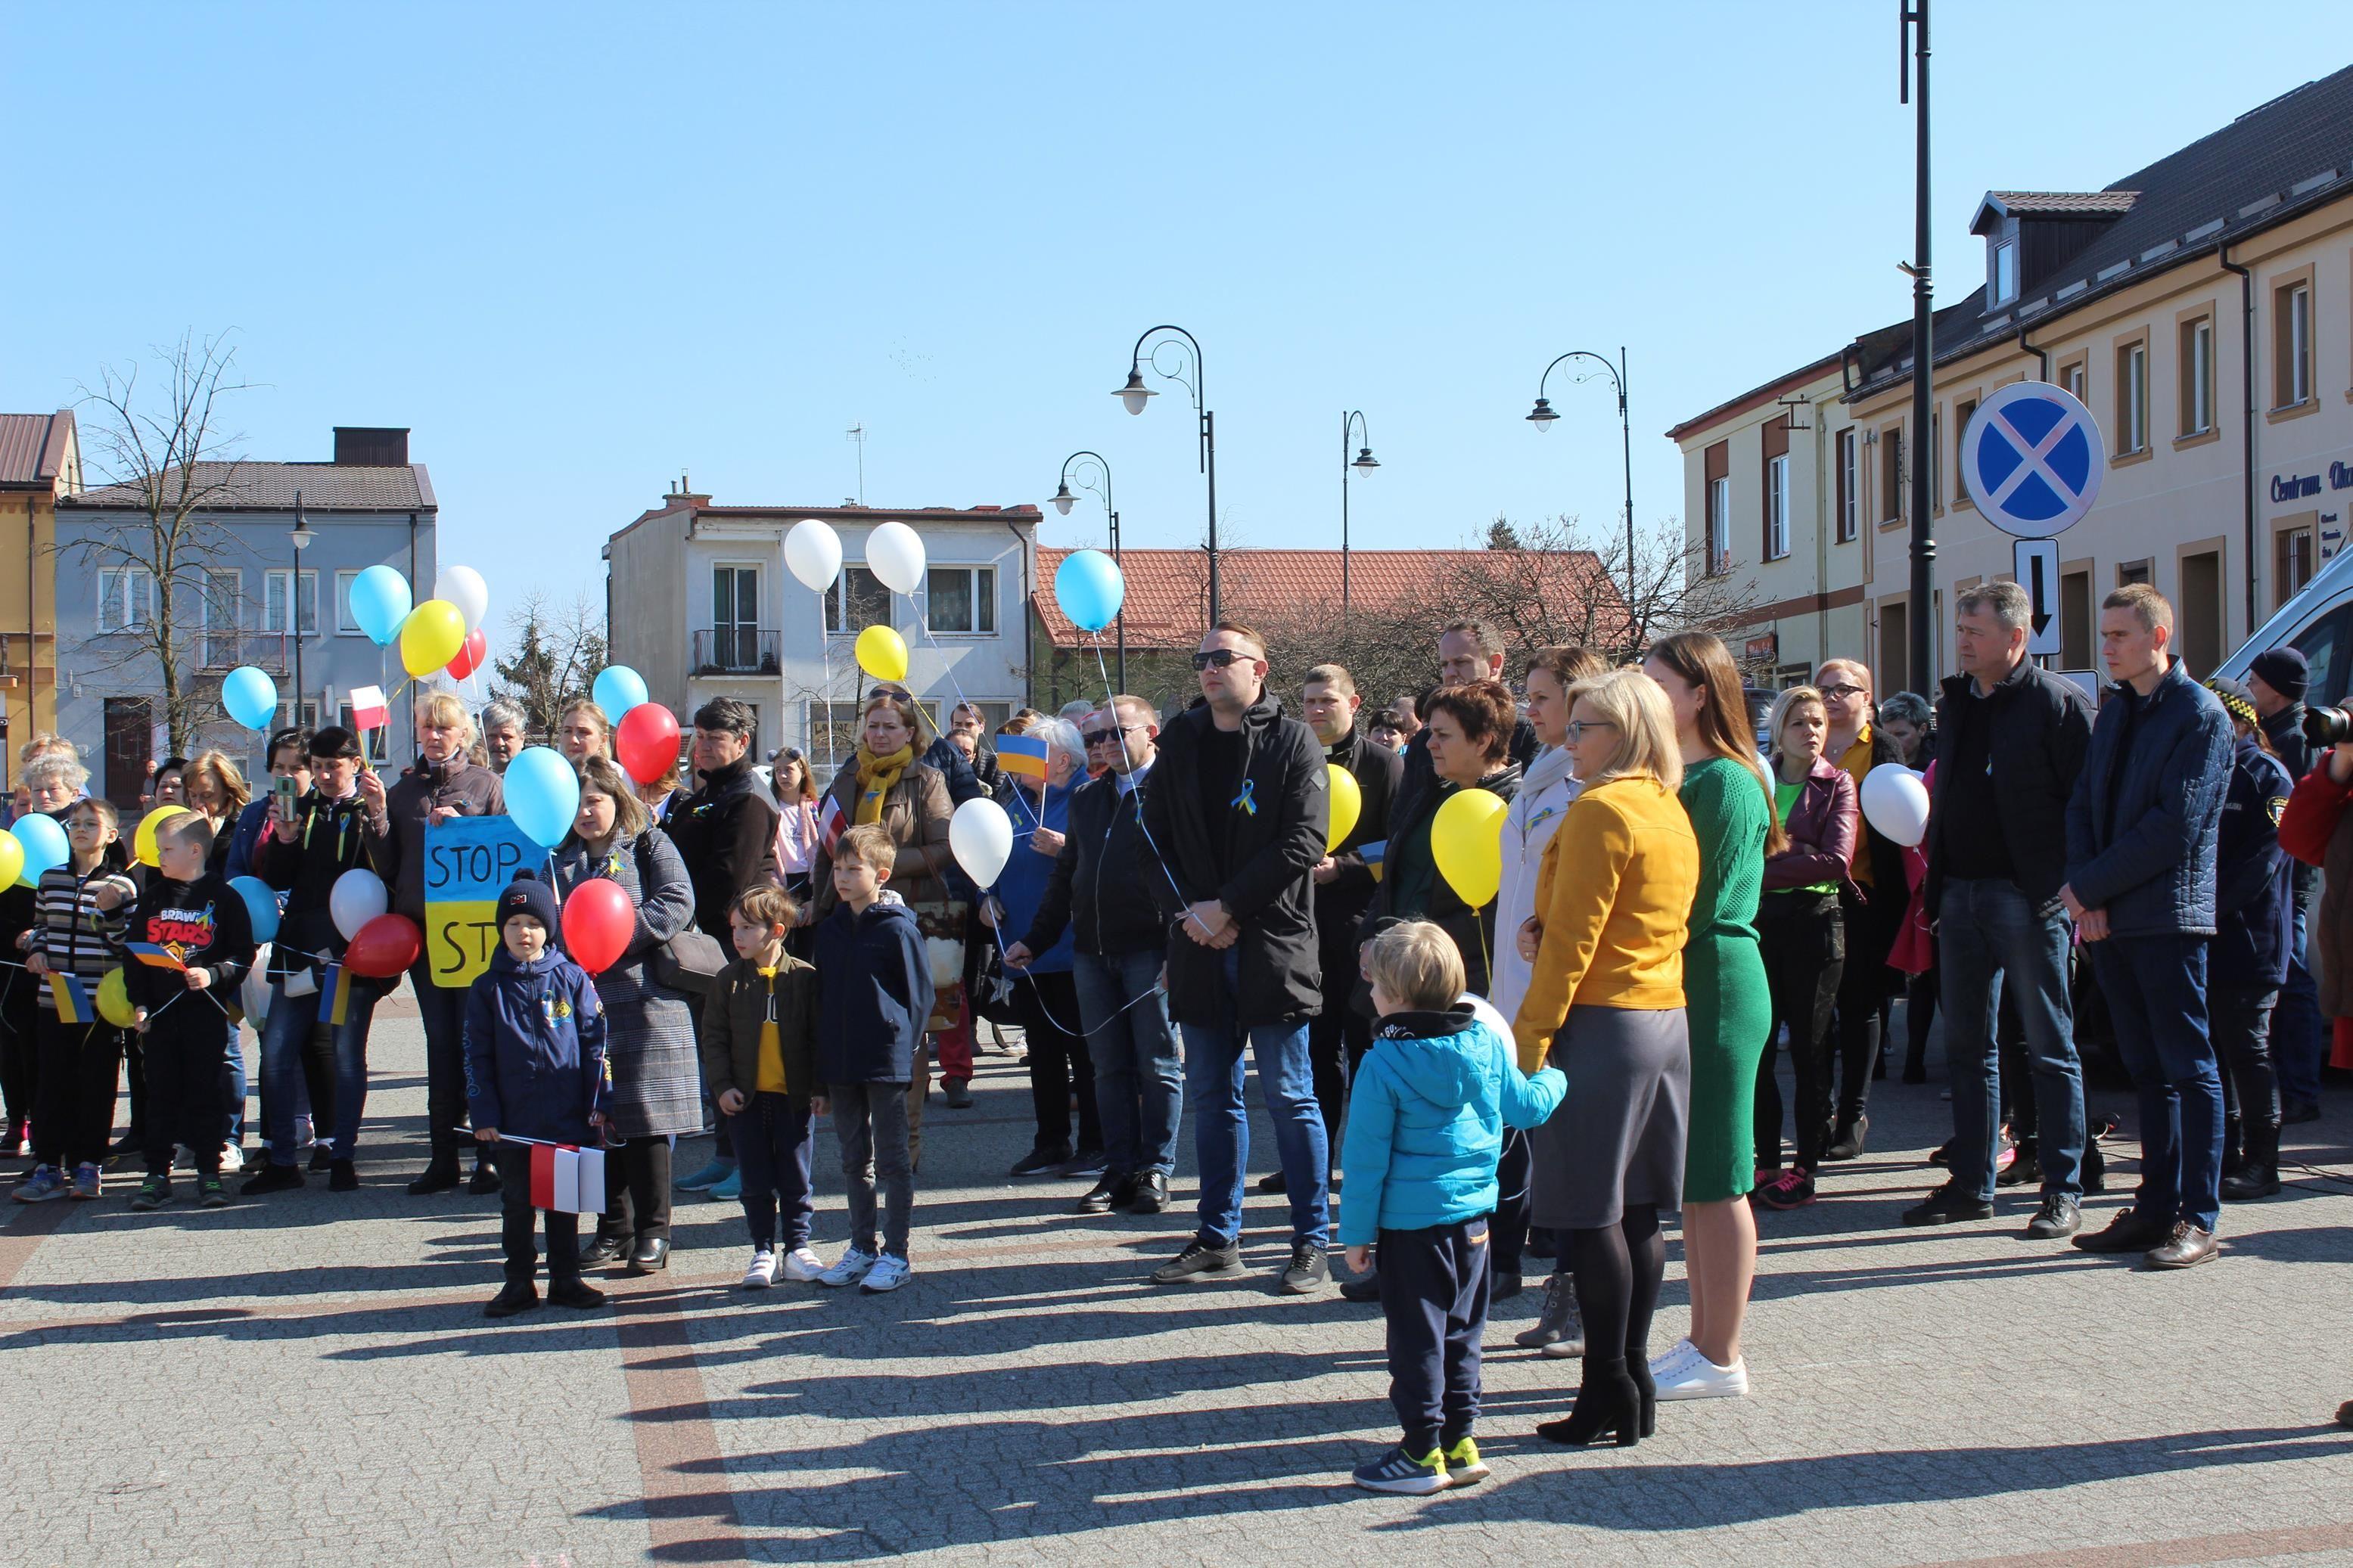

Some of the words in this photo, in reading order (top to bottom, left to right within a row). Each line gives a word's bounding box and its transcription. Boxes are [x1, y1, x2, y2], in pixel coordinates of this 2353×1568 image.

[2271, 474, 2322, 503] Centrum
[428, 842, 521, 888] STOP
[161, 909, 202, 922] BRAW
[148, 918, 212, 946] STARS
